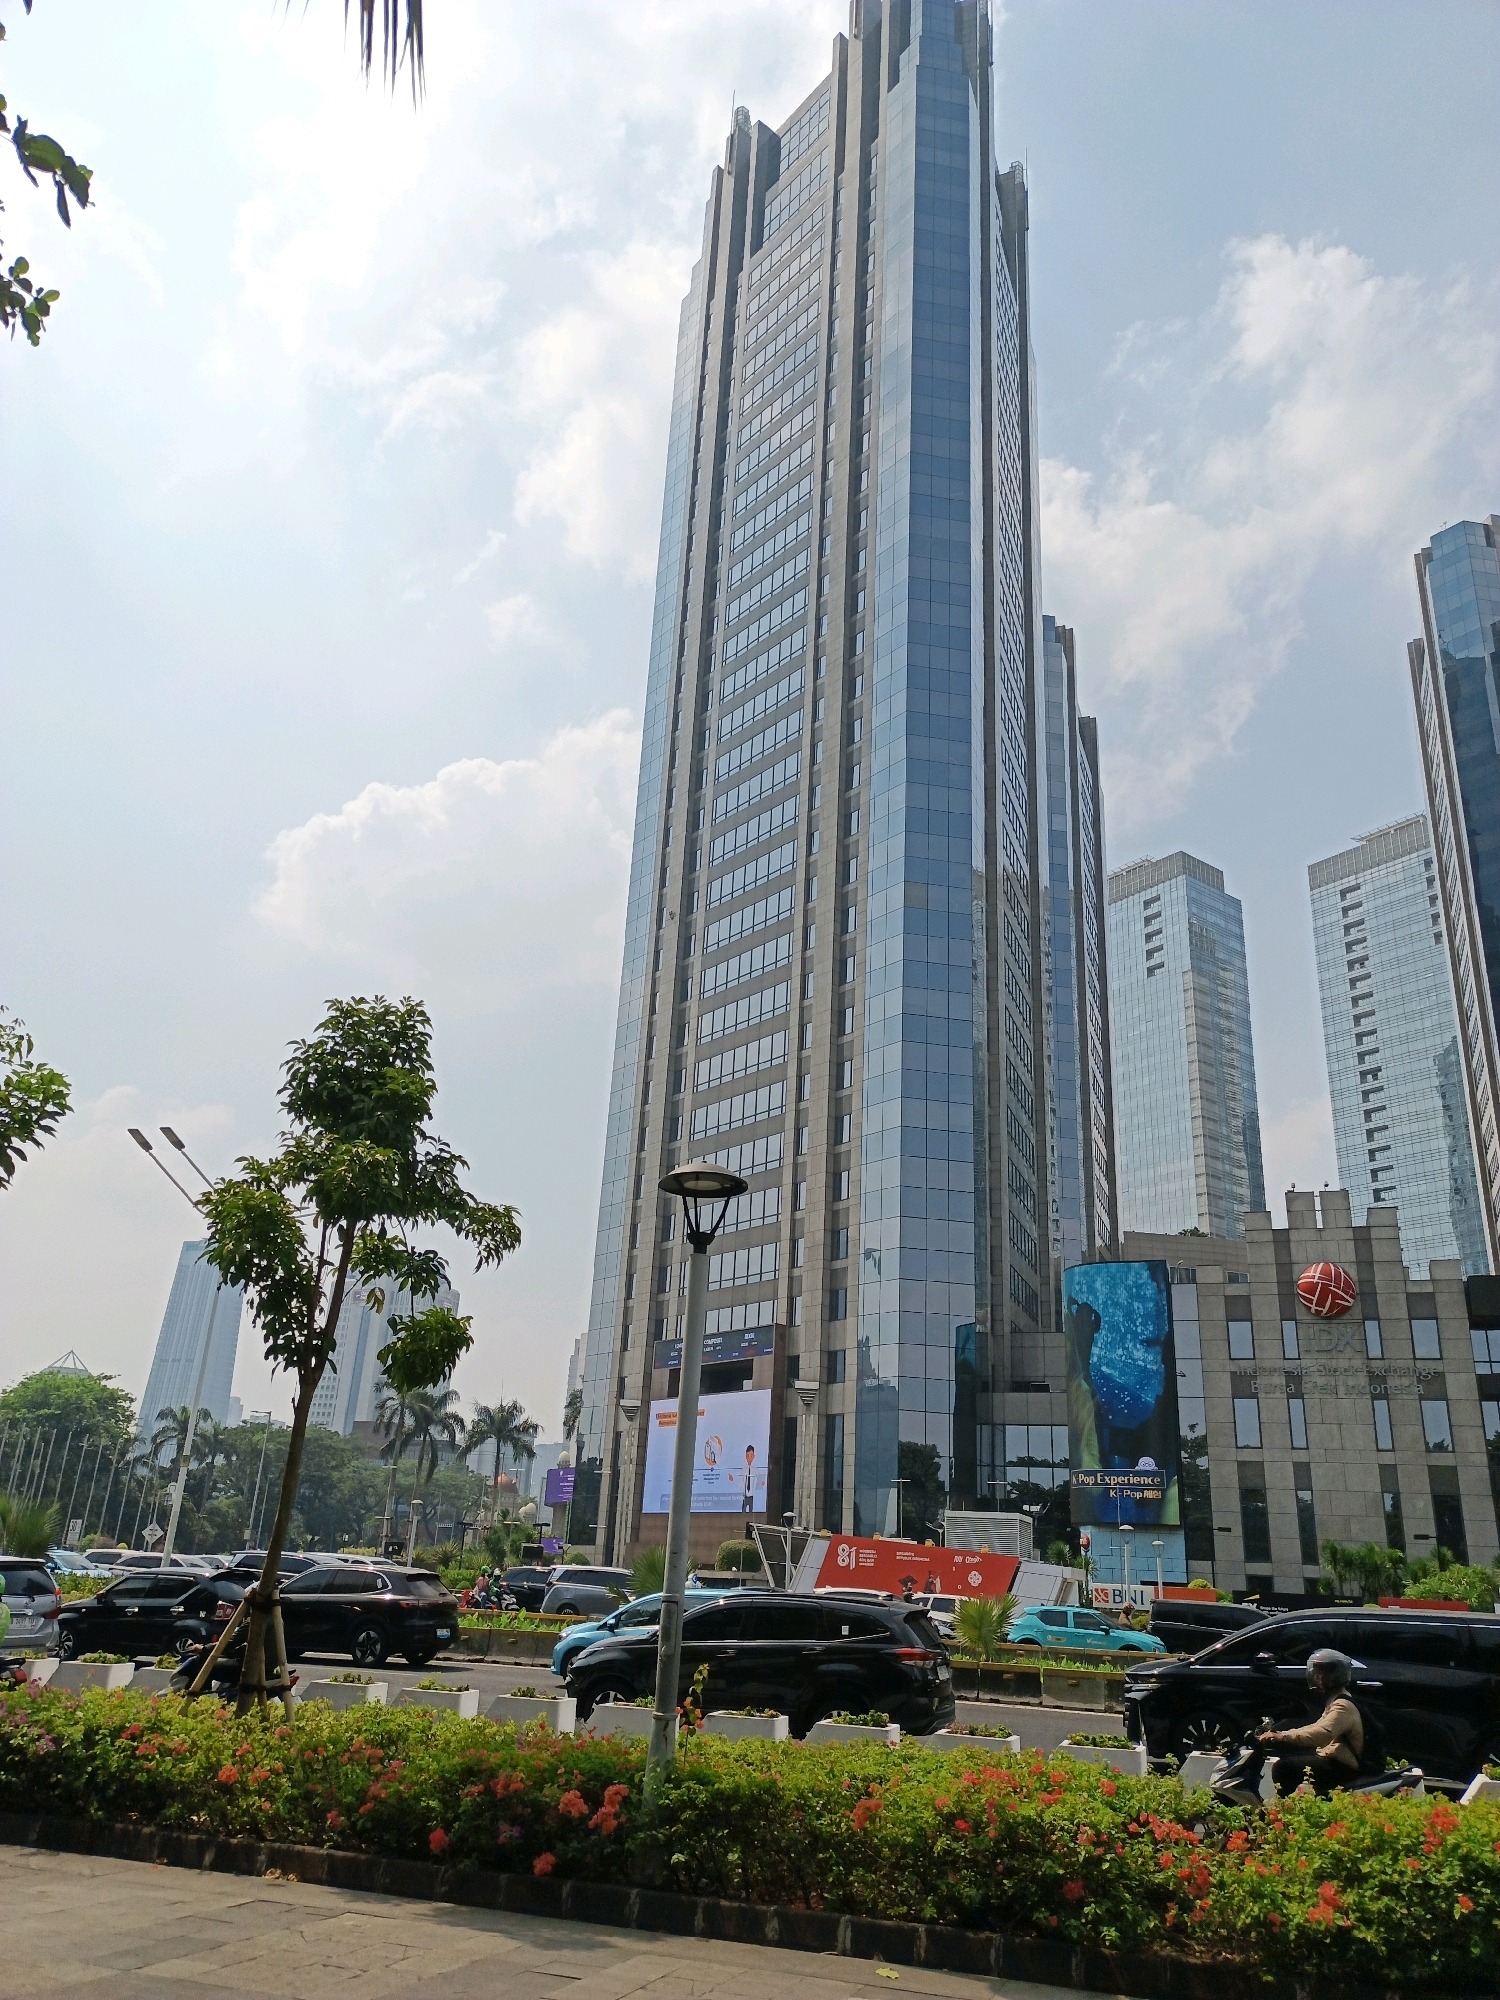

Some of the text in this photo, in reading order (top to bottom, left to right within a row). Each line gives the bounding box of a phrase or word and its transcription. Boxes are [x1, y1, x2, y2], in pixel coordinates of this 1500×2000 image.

[1303, 1323, 1363, 1353] IDX
[1236, 1363, 1439, 1381] Indonesia Stock Exchange
[1251, 1380, 1425, 1395] Bursa Efek Indonesia
[1072, 1472, 1161, 1486] K-Pop Experience
[837, 1543, 858, 1571] 81
[1112, 1588, 1145, 1605] BNI
